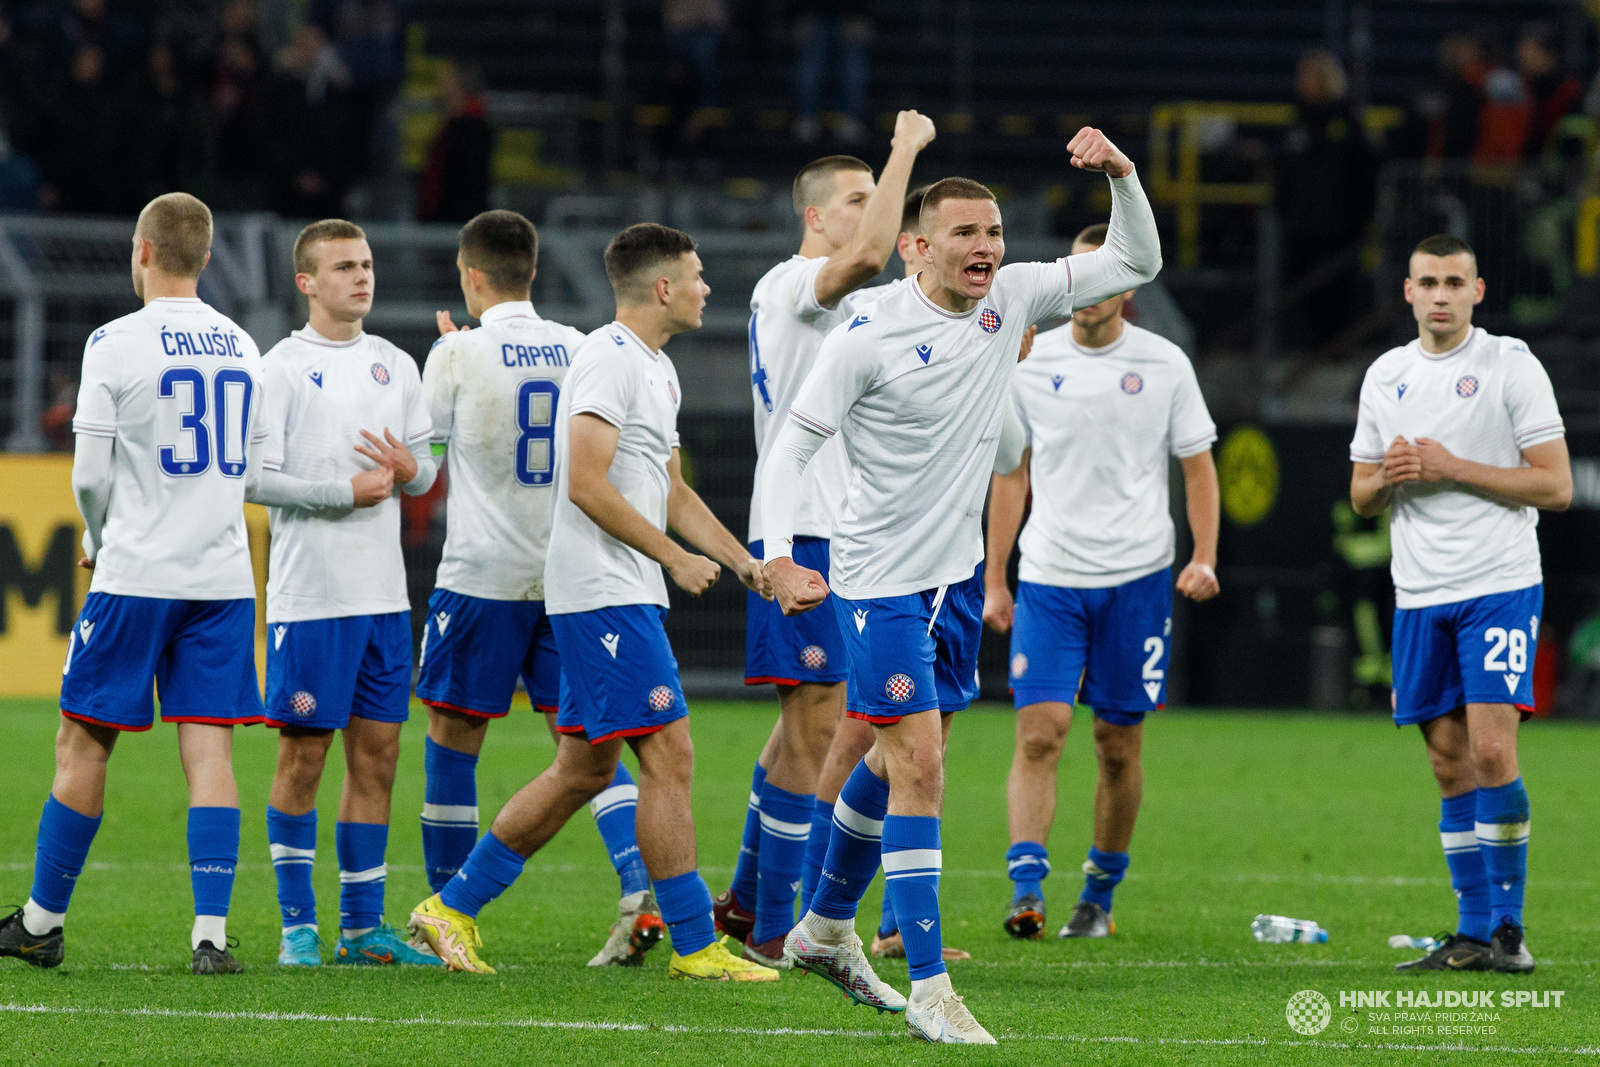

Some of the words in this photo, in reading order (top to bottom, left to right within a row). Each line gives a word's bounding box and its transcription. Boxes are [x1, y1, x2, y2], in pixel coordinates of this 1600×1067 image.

[160, 324, 244, 358] ĆALUŠIĆ
[157, 364, 254, 479] 30
[513, 376, 561, 488] 8
[1141, 635, 1165, 681] 2
[1483, 626, 1528, 674] 28
